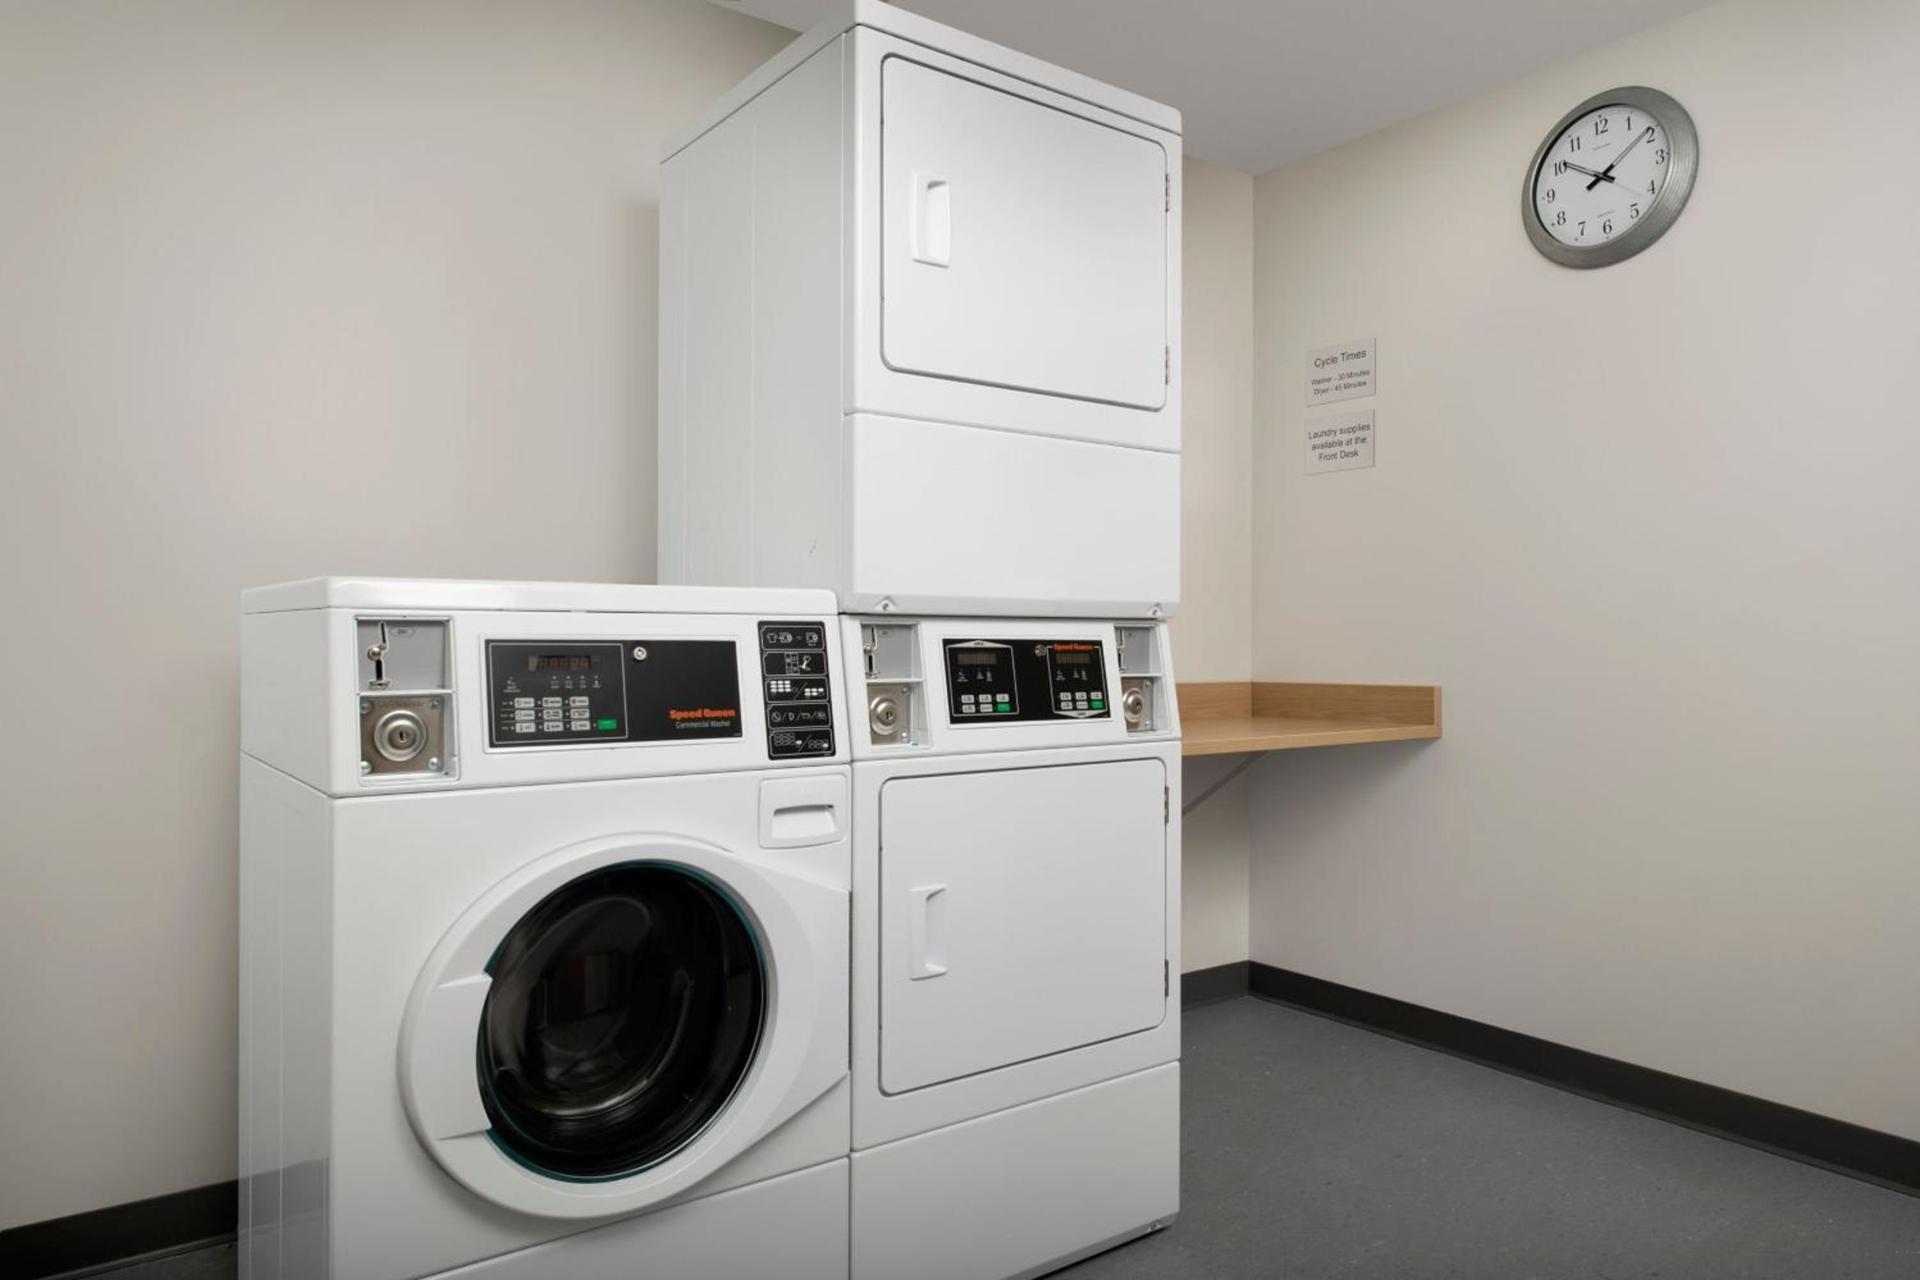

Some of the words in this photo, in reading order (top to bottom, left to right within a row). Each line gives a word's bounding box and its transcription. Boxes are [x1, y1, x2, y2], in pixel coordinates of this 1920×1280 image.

[1594, 117, 1609, 136] 12
[1625, 116, 1631, 131] 1
[1645, 126, 1656, 143] 2
[1569, 136, 1581, 152] 11
[1655, 148, 1665, 165] 3
[1554, 160, 1568, 176] 10
[1647, 179, 1656, 195] 4
[1546, 188, 1555, 203] 9
[1556, 210, 1566, 226] 8
[1630, 202, 1640, 219] 5
[1577, 220, 1586, 236] 7
[1603, 219, 1613, 235] 6
[1313, 356, 1338, 369] Cycle
[1340, 350, 1367, 363] Times
[1308, 429, 1337, 440] Laundry
[1338, 424, 1371, 436] supplies
[1311, 440, 1344, 451] available
[1345, 437, 1353, 446] at
[1354, 436, 1367, 445] the
[1318, 452, 1338, 461] Front
[1339, 449, 1360, 459] Desk
[669, 709, 702, 720] Speed
[703, 708, 736, 718] Queen
